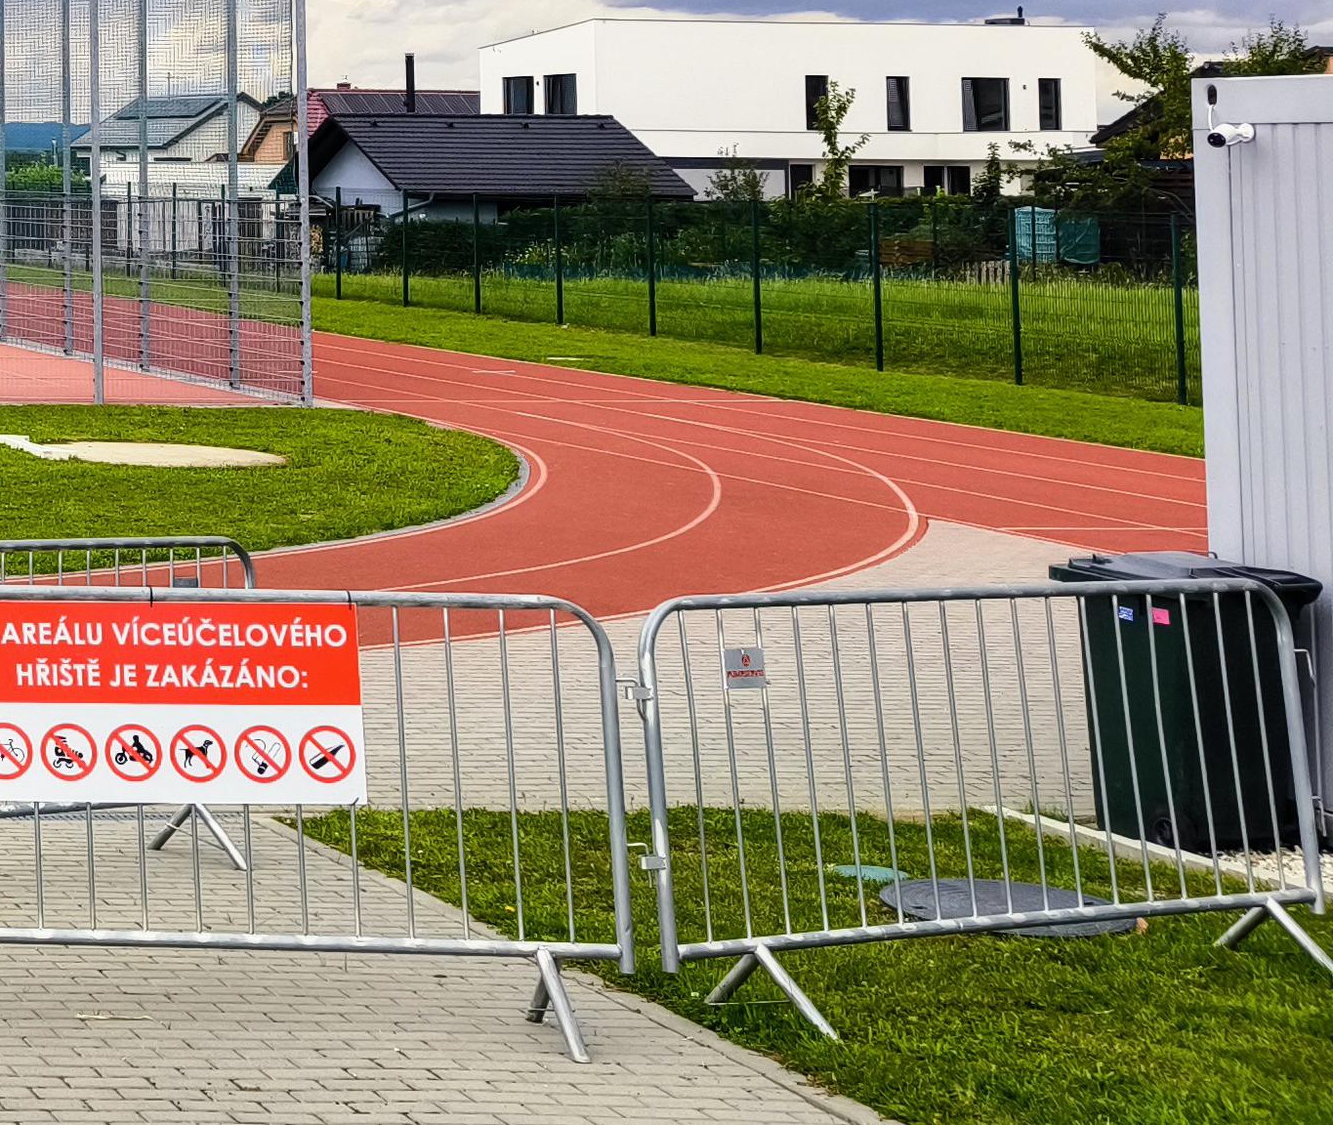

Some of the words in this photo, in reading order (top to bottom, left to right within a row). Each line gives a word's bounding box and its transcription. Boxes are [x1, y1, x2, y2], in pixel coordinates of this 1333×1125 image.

[0, 615, 103, 646] AREÁLU
[111, 616, 347, 647] VÍCEÚČELOVÉHO
[16, 658, 101, 687] HŘIŠTĚ
[109, 664, 138, 687] JE
[144, 658, 308, 688] ZAKÁZÁNO:
